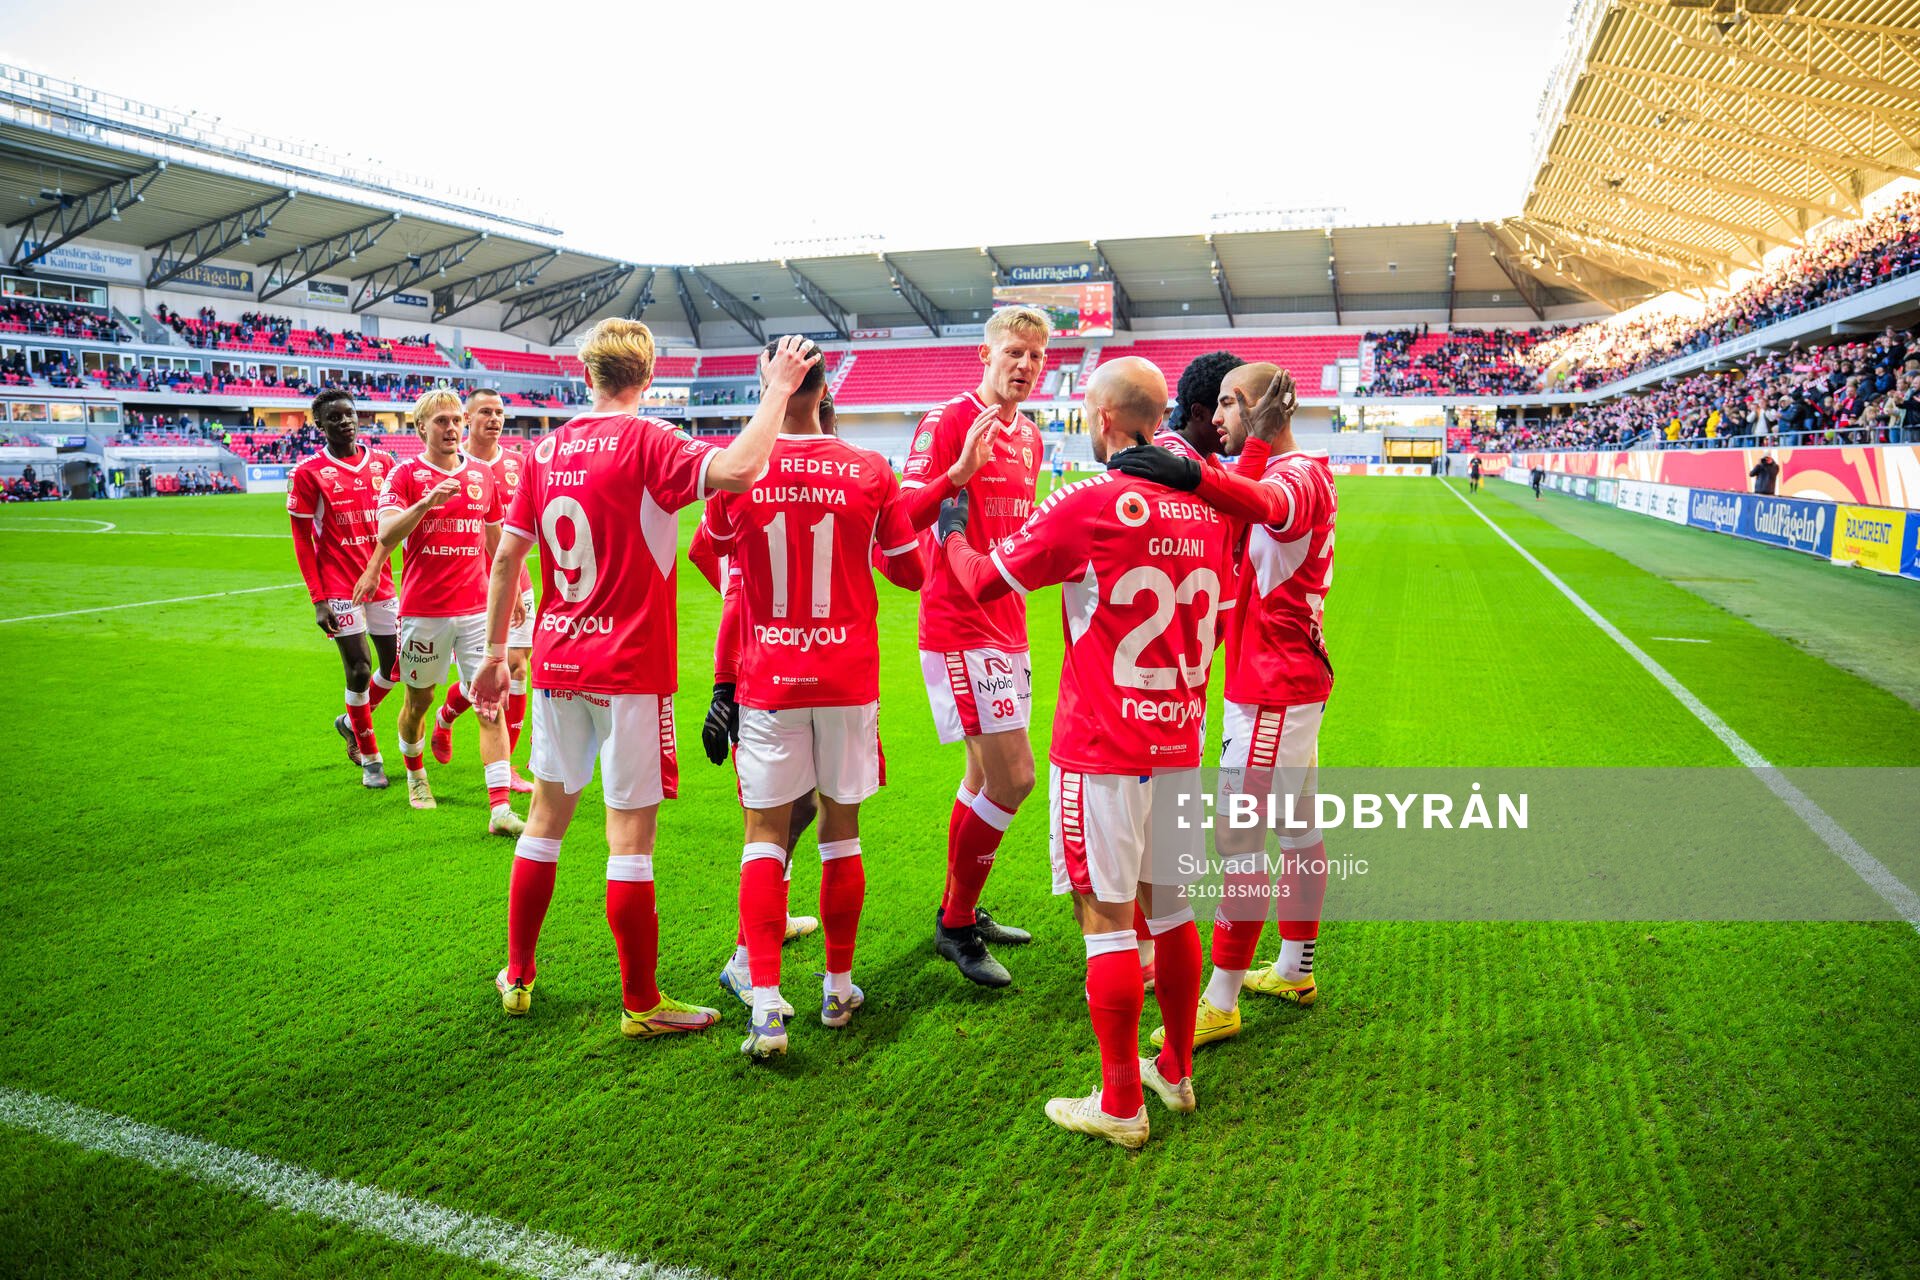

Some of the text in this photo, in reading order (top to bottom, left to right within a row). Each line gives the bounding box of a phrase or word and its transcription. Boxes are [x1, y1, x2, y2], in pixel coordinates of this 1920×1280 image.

[157, 261, 240, 285] GdFågeln
[1012, 266, 1079, 281] GuldFågeln
[558, 436, 619, 455] REDEYE
[547, 470, 587, 487] STOLT
[780, 458, 861, 478] REDEYE
[752, 486, 847, 506] OLUSANYA
[1158, 501, 1220, 524] REDEYE
[1692, 492, 1736, 529] GuldFågeln
[1754, 500, 1815, 547] GuldFågeln
[1846, 517, 1893, 545] RAMIRENT
[340, 533, 380, 547] ALEMT
[541, 495, 597, 603] 9
[1148, 537, 1205, 558] GOJANI
[421, 545, 481, 557] ALEMTEK
[763, 511, 835, 618] 11
[339, 614, 354, 627] 20
[1109, 566, 1221, 691] 23
[754, 624, 847, 652] nearyou
[402, 650, 440, 664] Nybloms
[410, 669, 418, 681] 4
[991, 697, 1015, 719] 39
